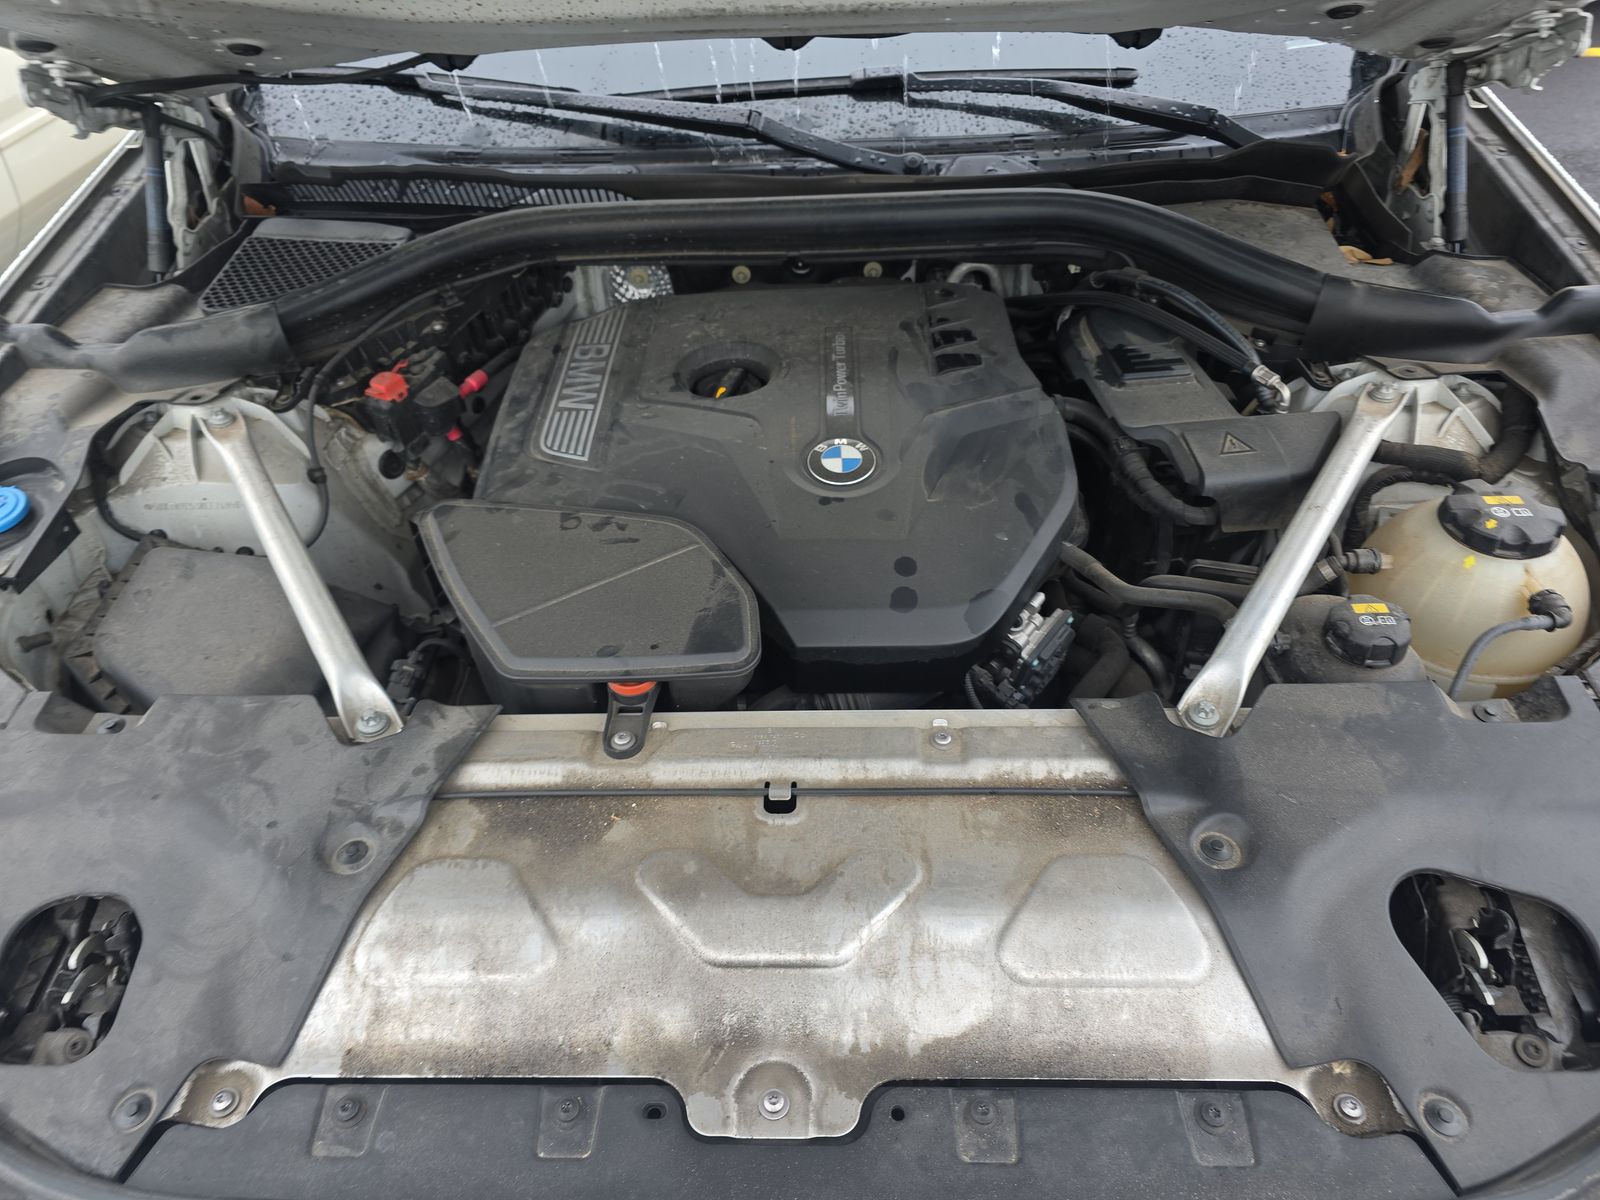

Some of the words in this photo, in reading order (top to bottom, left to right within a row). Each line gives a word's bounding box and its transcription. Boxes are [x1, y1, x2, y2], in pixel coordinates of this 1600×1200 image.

[831, 333, 847, 361] Turbo
[557, 343, 612, 410] BMW
[832, 361, 849, 416] TwinPower
[814, 438, 869, 453] BMW
